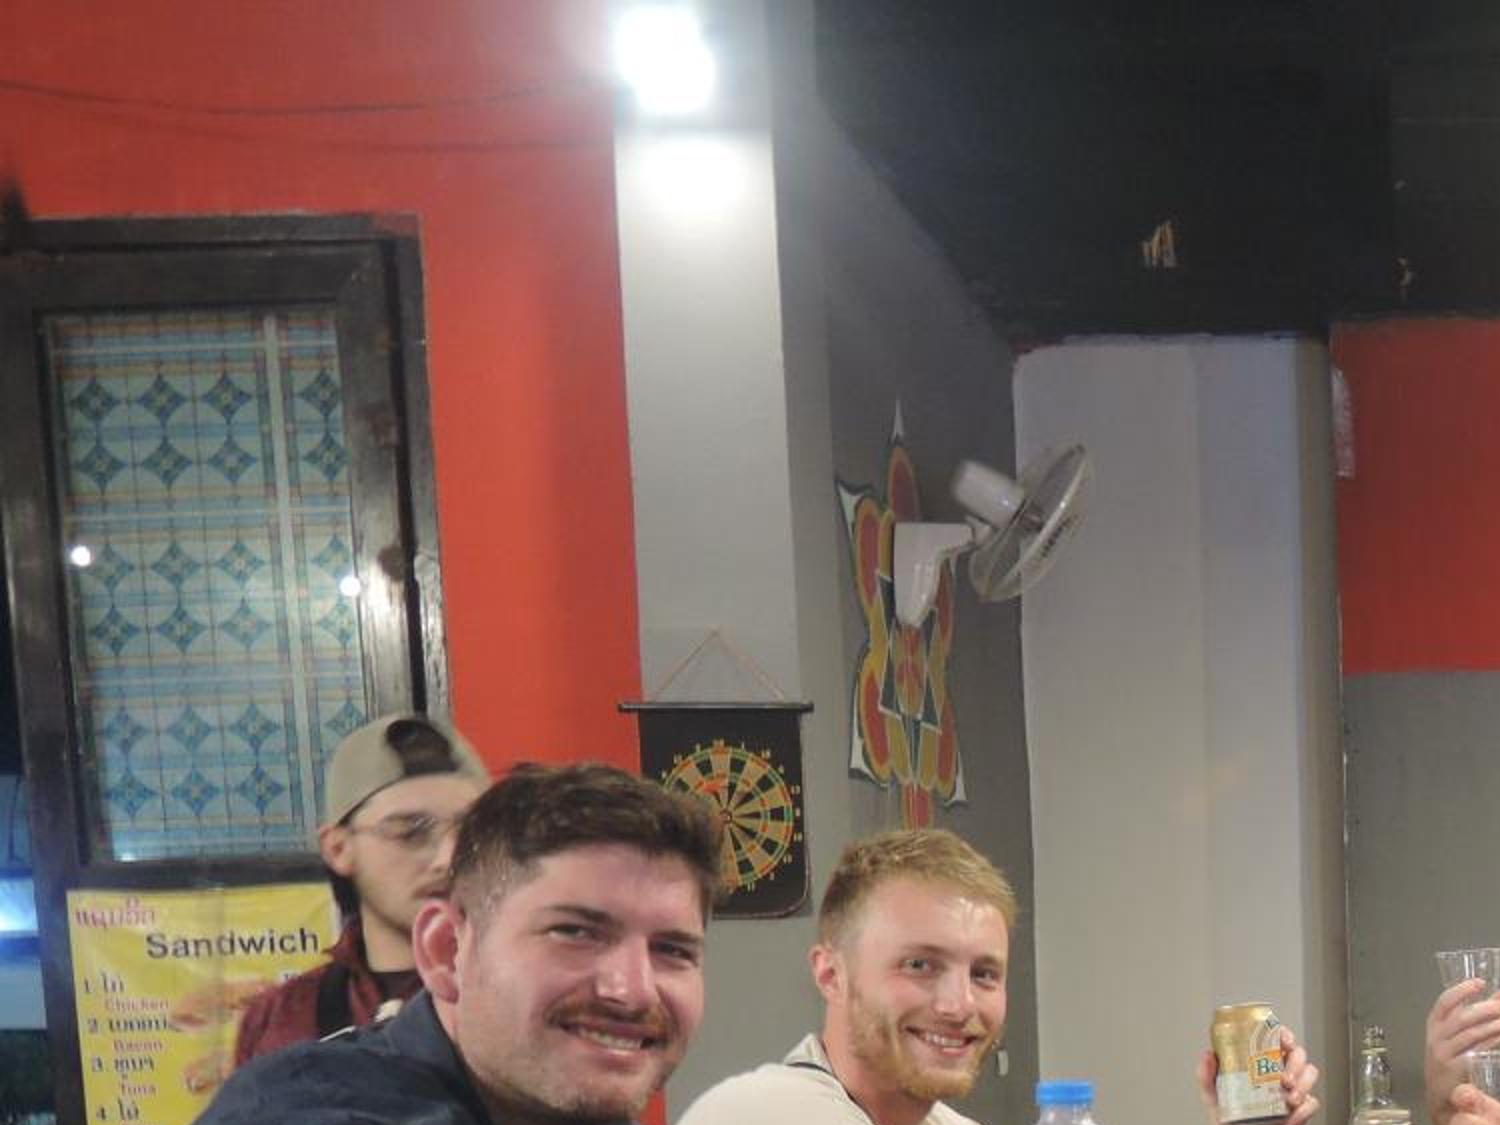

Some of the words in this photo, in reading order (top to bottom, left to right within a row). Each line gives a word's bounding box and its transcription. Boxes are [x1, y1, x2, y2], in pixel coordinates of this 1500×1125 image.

[146, 927, 319, 959] Sandwich
[105, 997, 169, 1011] Chicken
[113, 1039, 163, 1053] Bacon
[1256, 1057, 1283, 1077] Be
[121, 1082, 157, 1096] Tuna
